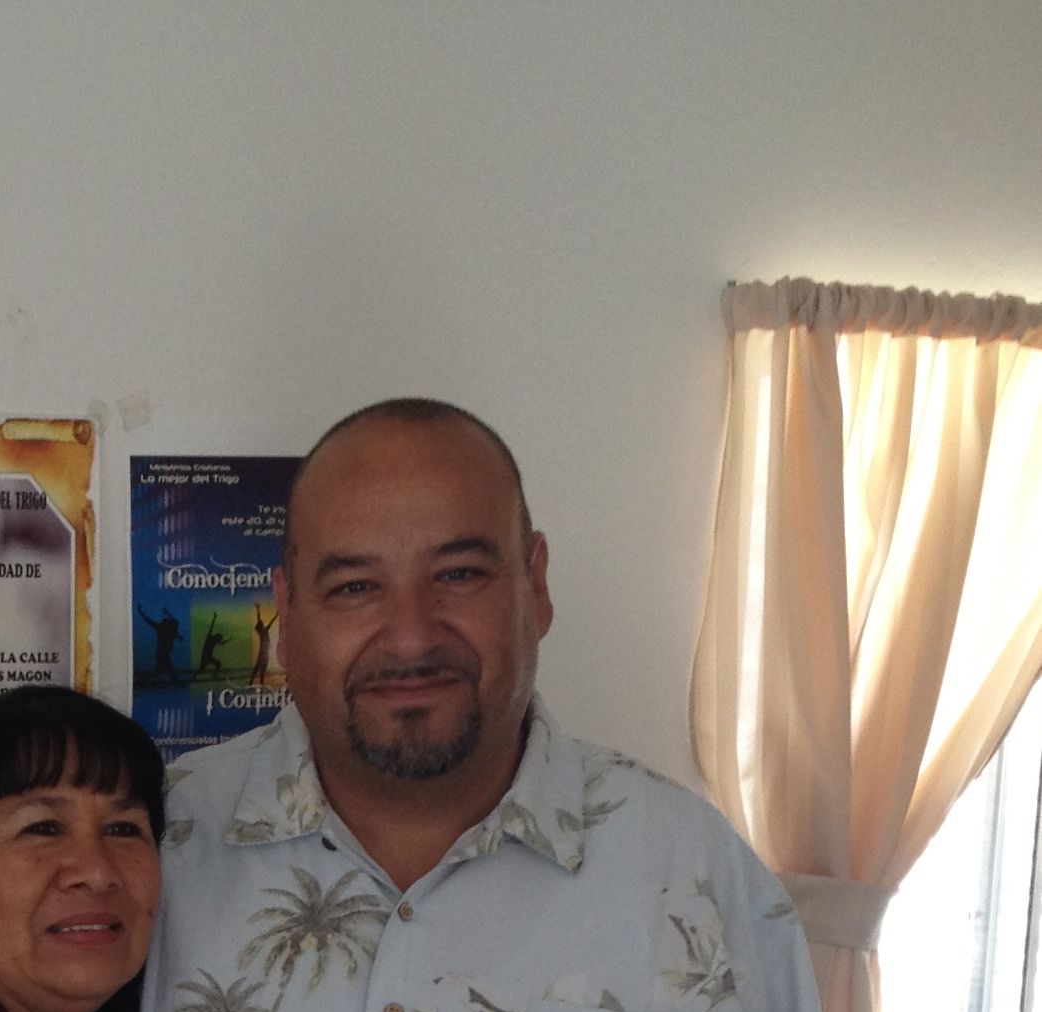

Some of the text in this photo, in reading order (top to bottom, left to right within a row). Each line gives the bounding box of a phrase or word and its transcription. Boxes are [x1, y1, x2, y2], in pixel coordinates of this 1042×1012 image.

[140, 474, 240, 485] Lo mejor del Trigo
[15, 491, 47, 511] TRIGO
[26, 564, 41, 578] DE
[165, 564, 272, 596] Conociend
[0, 653, 16, 663] LA
[20, 652, 60, 664] CALLE
[7, 671, 52, 682] MAGON
